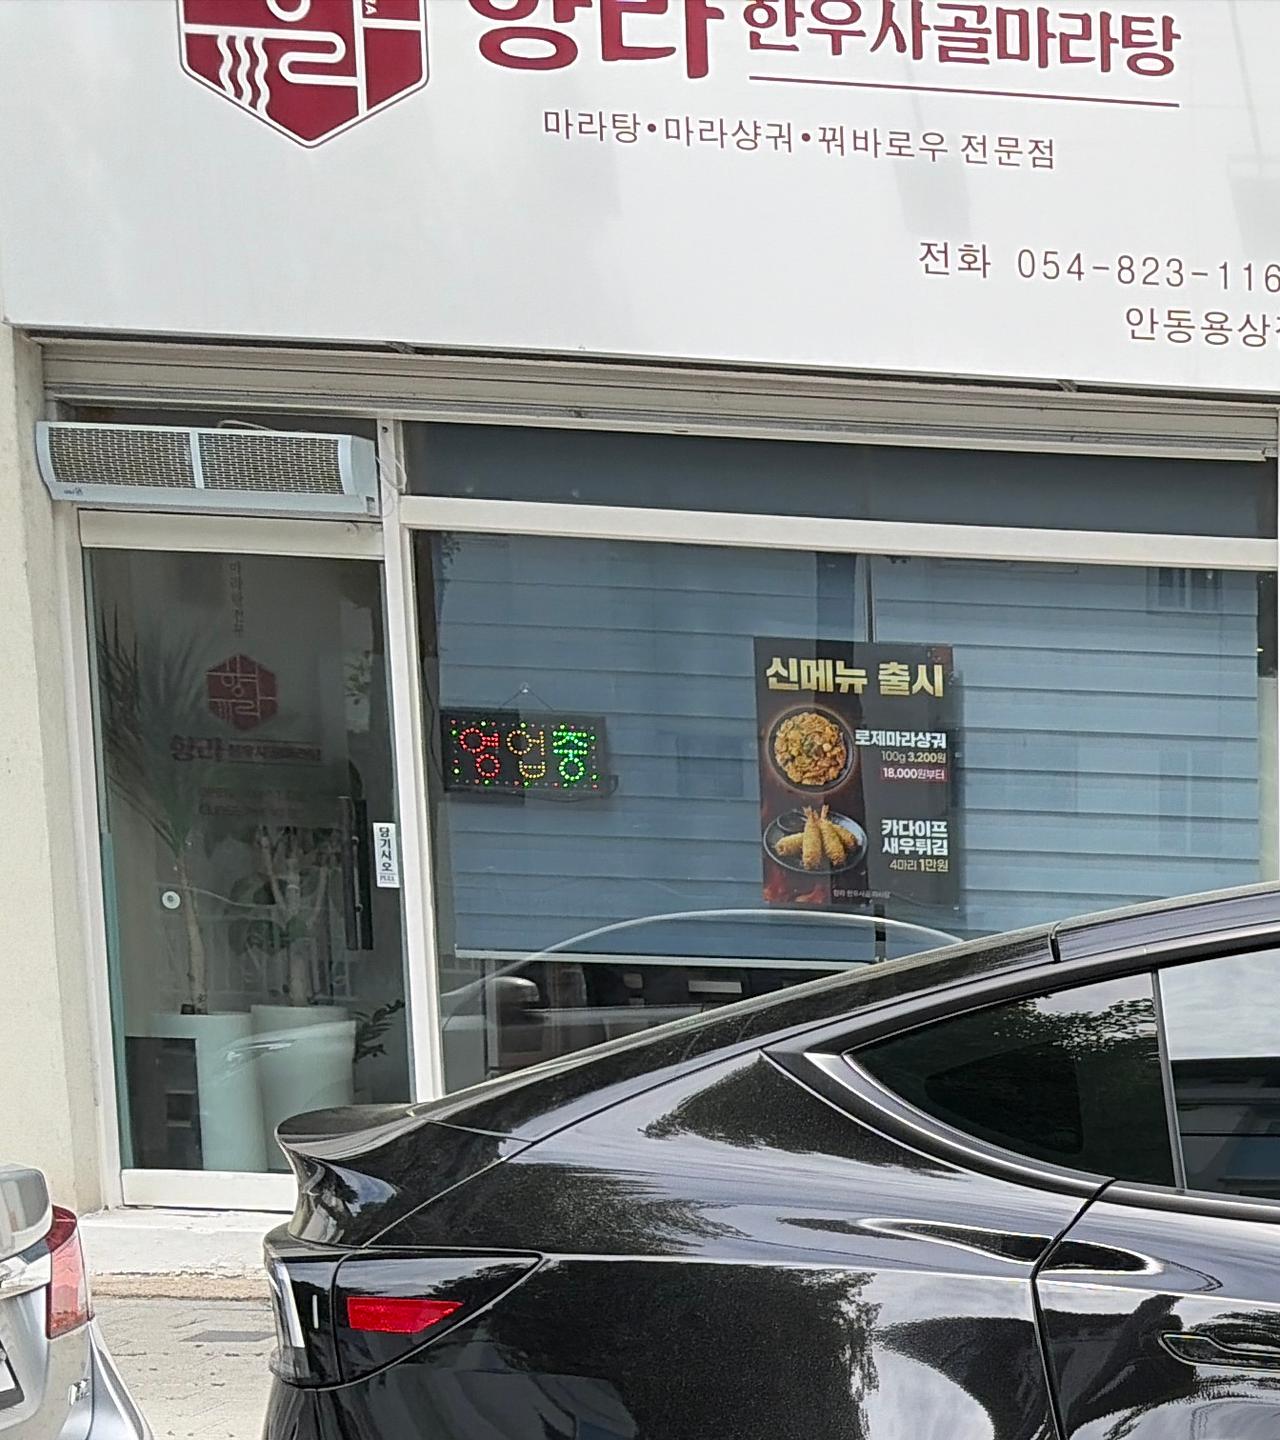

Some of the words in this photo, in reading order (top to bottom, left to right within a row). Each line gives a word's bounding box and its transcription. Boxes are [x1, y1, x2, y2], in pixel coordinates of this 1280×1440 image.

[741, 0, 1182, 77] 한우사골마라탕
[959, 135, 1057, 170] 전문점
[918, 240, 992, 281] 전화
[765, 657, 869, 694] 신메뉴
[878, 661, 944, 697] 출시
[459, 728, 590, 781] 영업중
[881, 819, 949, 838] 카다이프
[882, 837, 949, 856] 새우튀김
